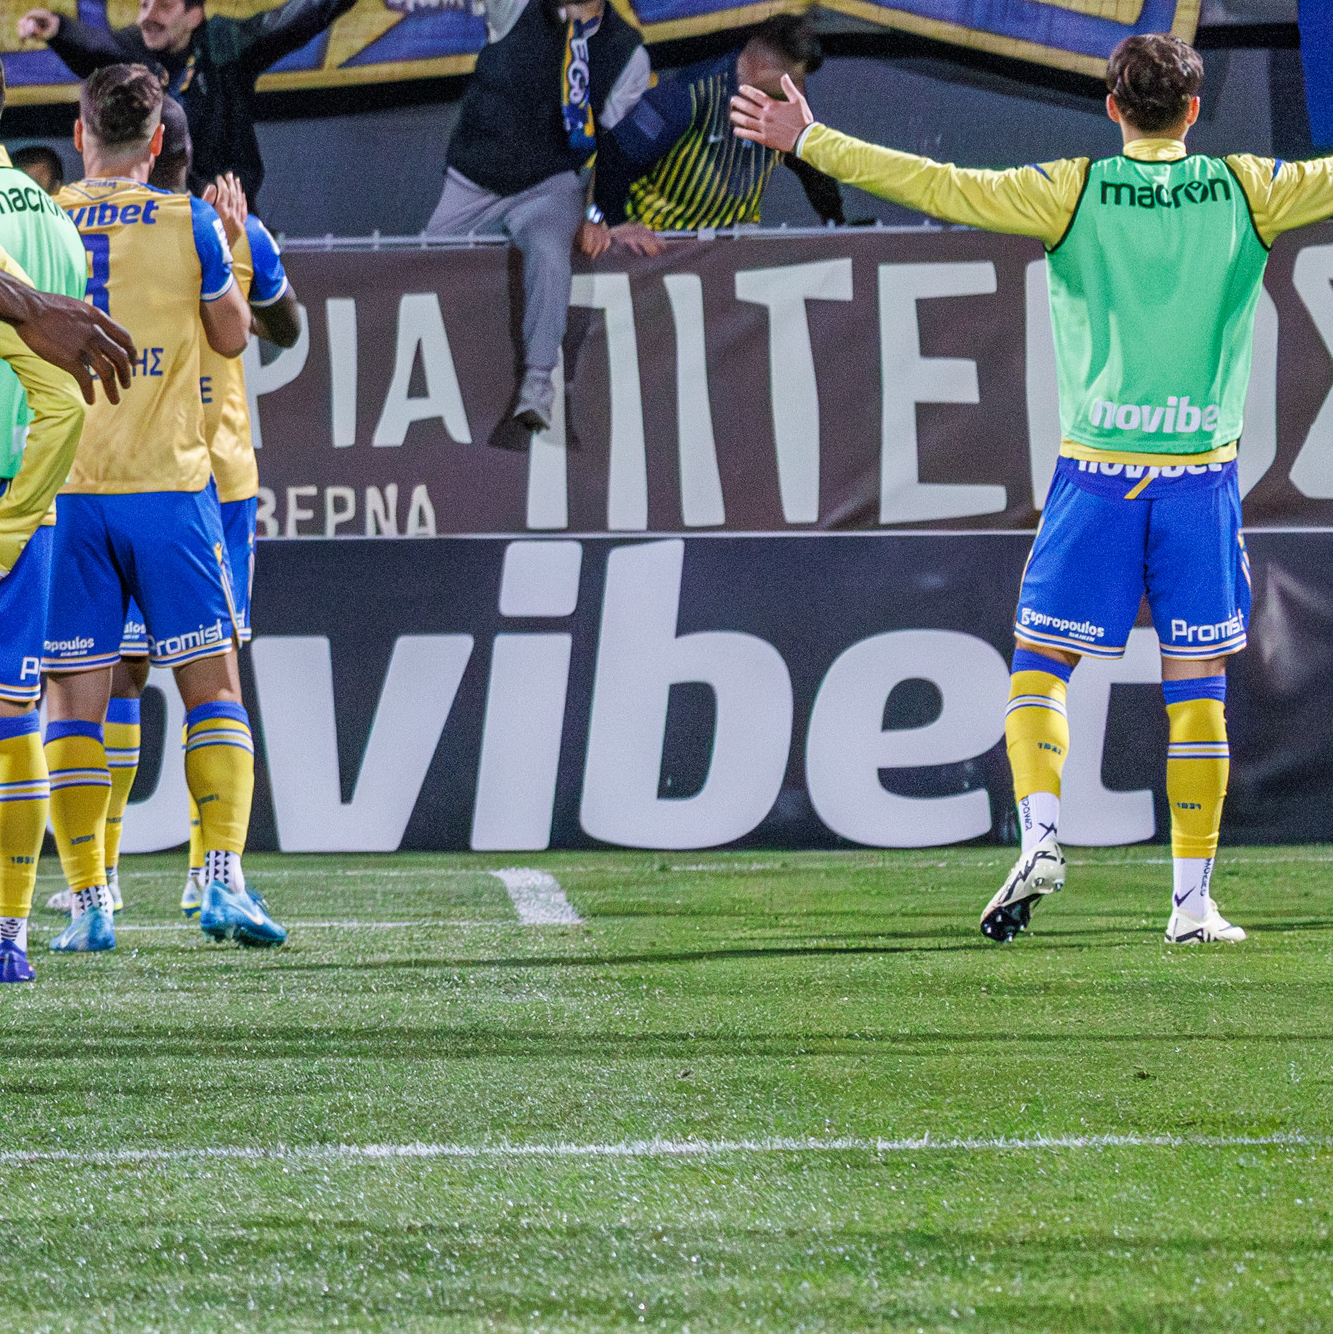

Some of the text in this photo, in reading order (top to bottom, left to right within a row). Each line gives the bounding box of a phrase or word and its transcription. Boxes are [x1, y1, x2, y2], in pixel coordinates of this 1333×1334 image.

[1100, 177, 1231, 208] macron
[1030, 608, 1245, 643] spiropoulos Promist
